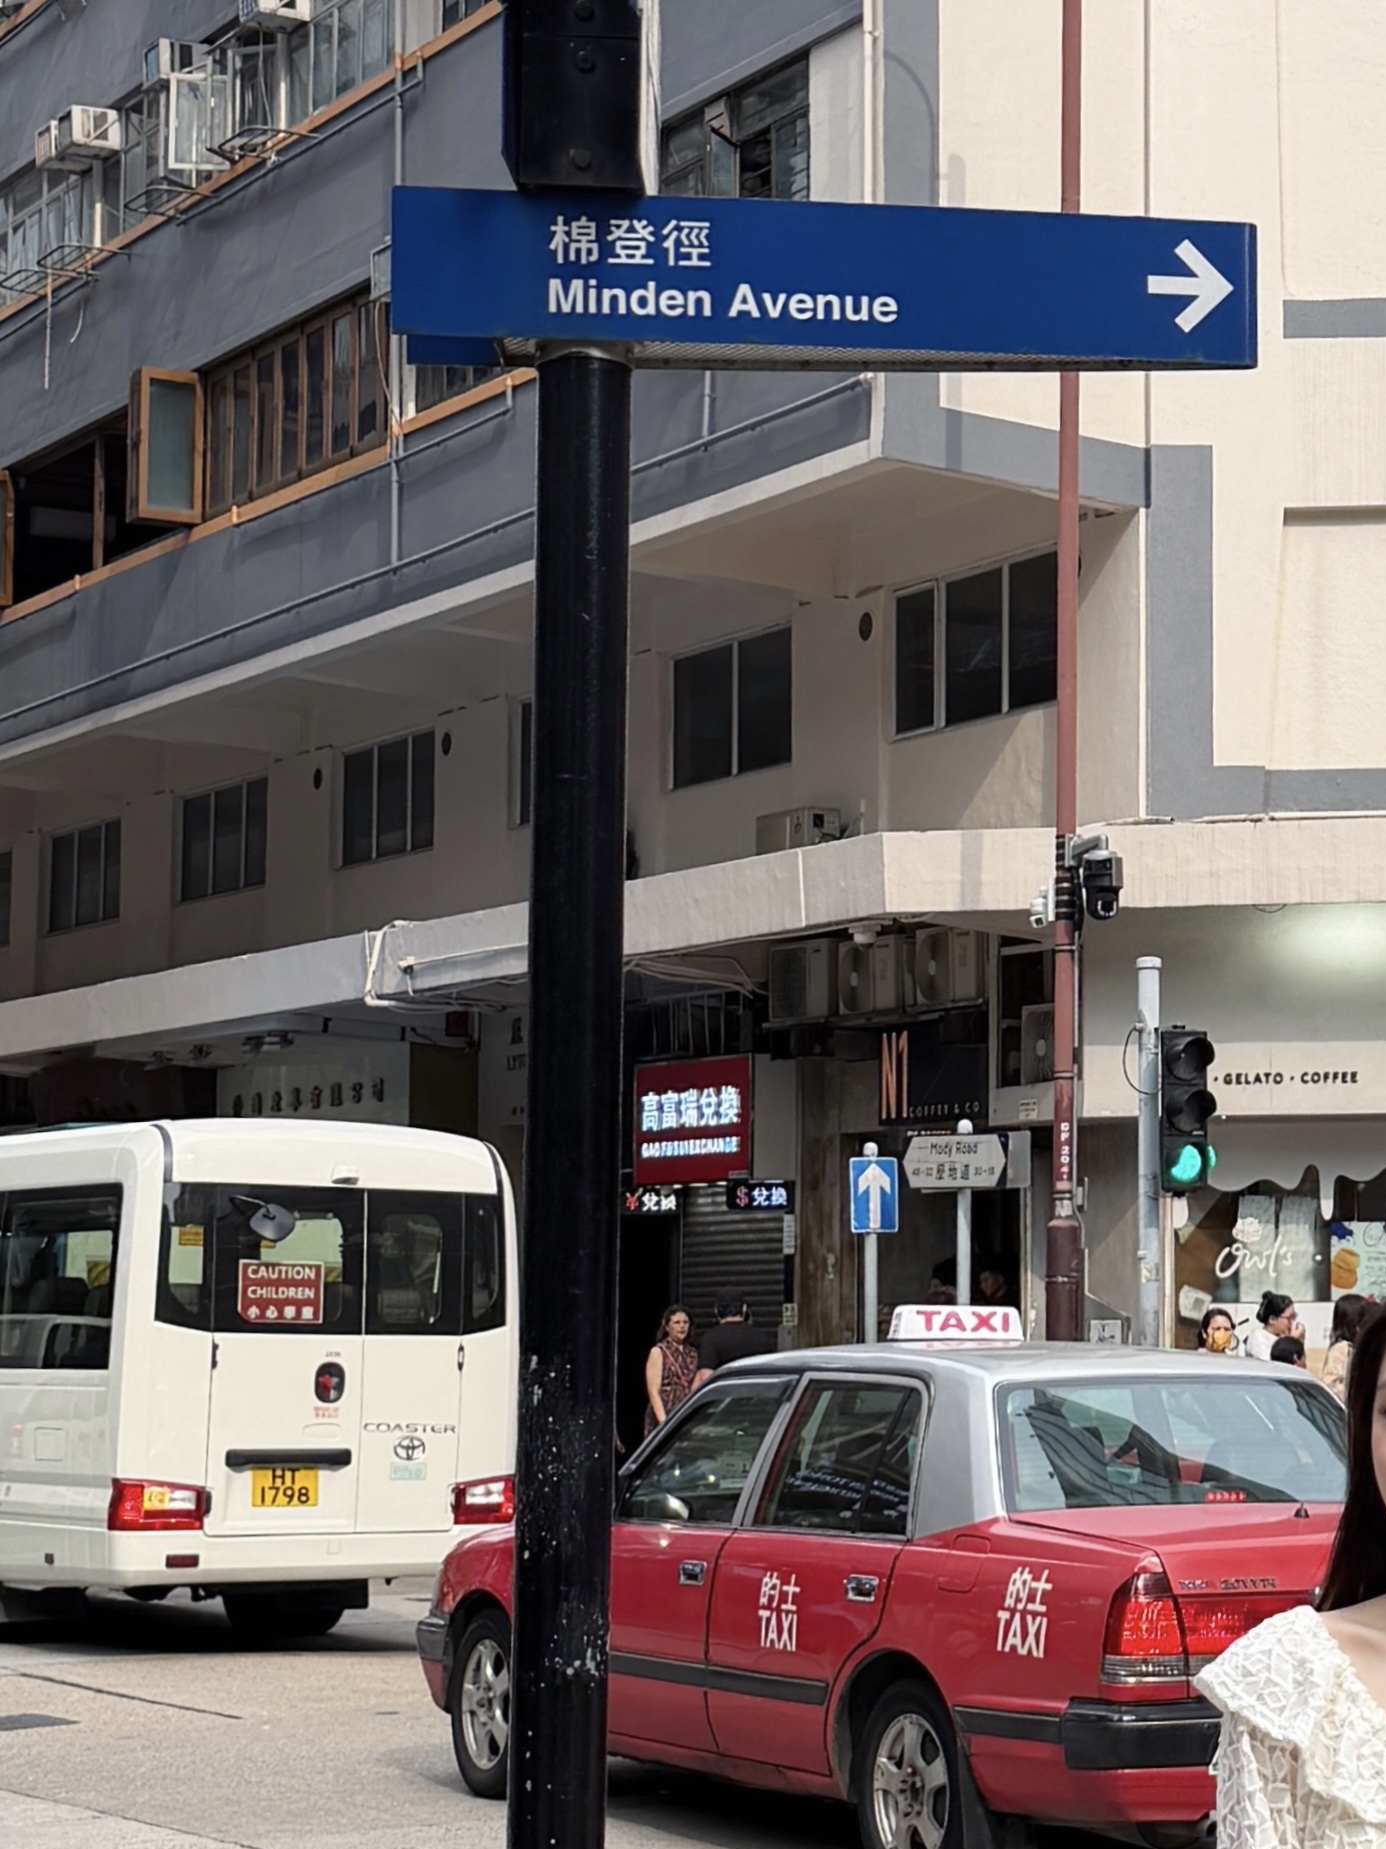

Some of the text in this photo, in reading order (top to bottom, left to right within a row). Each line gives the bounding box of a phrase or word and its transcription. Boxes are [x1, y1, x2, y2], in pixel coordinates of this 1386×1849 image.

[549, 215, 712, 267] 棉登徑
[547, 278, 899, 323] Minden Avenue
[1223, 1071, 1359, 1085] GELATO COFFEE
[956, 1141, 978, 1154] Road
[1215, 1234, 1293, 1279] Owl's
[248, 1266, 316, 1280] CAUTION
[248, 1286, 315, 1299] CHILDREN
[916, 1310, 1010, 1333] TAXI
[363, 1423, 456, 1434] COASTER
[271, 1467, 299, 1486] HT
[260, 1486, 310, 1505] 1798
[760, 1570, 800, 1612] 的士
[1005, 1566, 1053, 1613] 的士
[758, 1609, 798, 1652] TAXI
[996, 1610, 1048, 1659] TAXI
